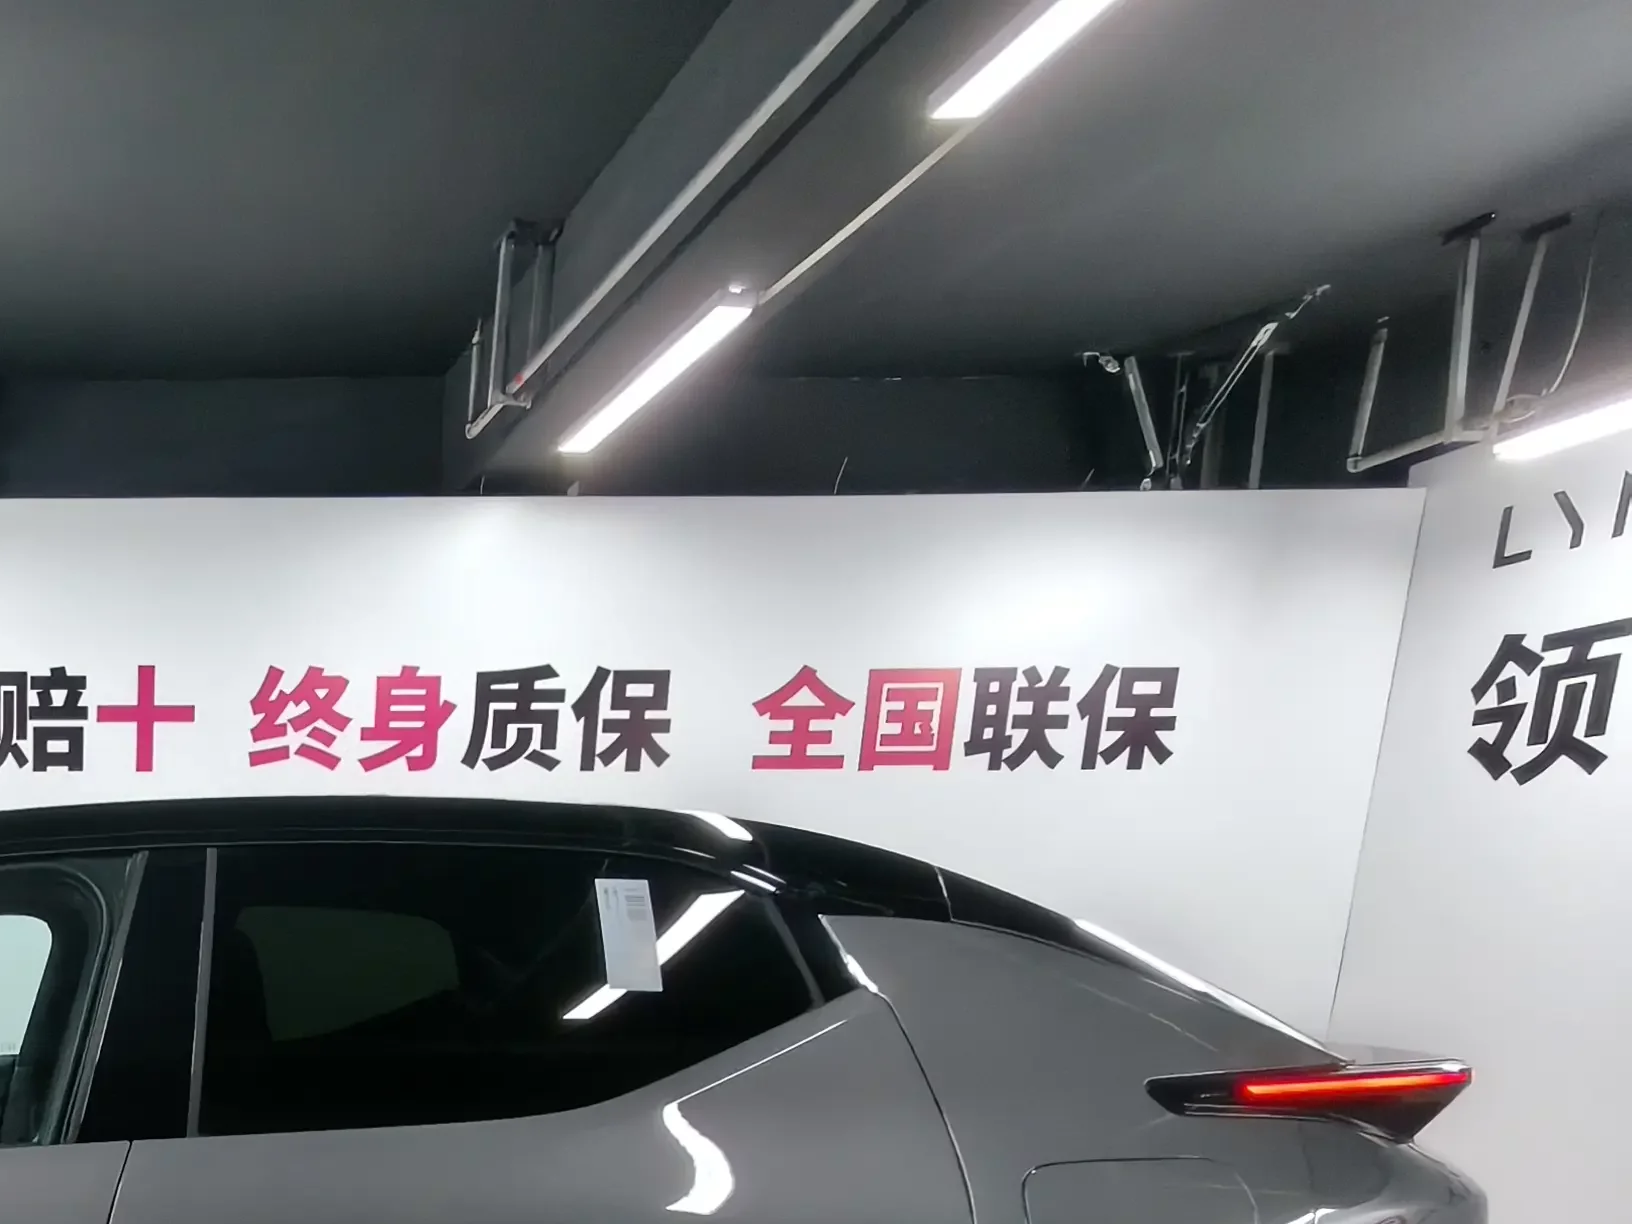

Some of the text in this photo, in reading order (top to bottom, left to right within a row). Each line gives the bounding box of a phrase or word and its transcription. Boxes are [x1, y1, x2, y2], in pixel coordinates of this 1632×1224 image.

[248, 663, 671, 772] 终身质保
[751, 664, 1180, 772] 全国联保
[1467, 617, 1632, 786] 领
